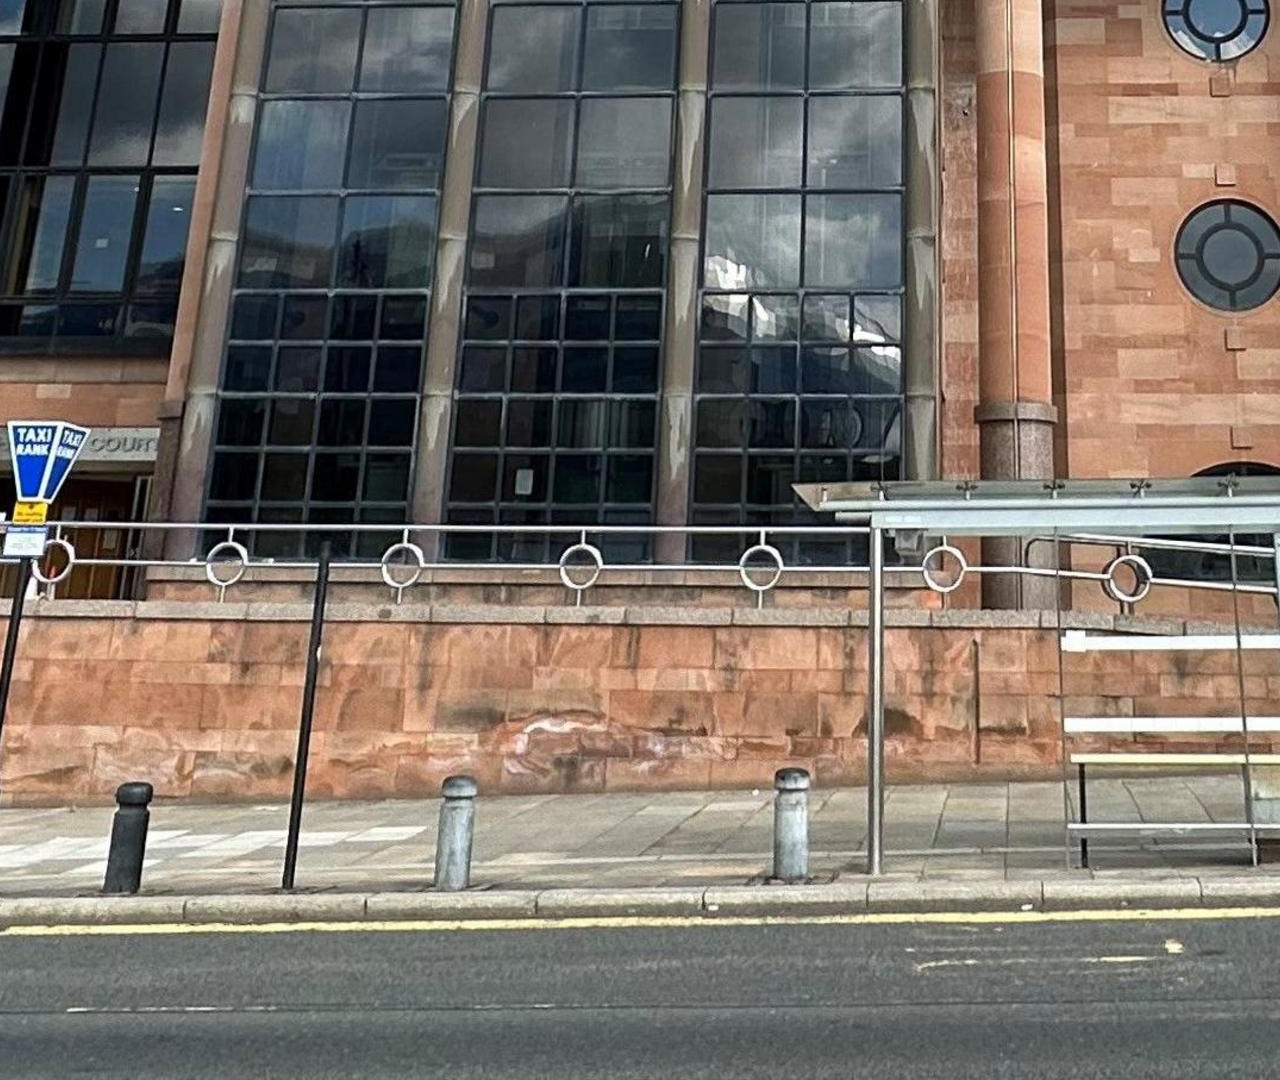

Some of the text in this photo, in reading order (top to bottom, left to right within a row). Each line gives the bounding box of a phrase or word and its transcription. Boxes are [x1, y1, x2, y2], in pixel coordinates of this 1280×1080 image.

[17, 427, 53, 442] TAXI
[62, 430, 83, 447] TAXI
[16, 443, 50, 455] RANK
